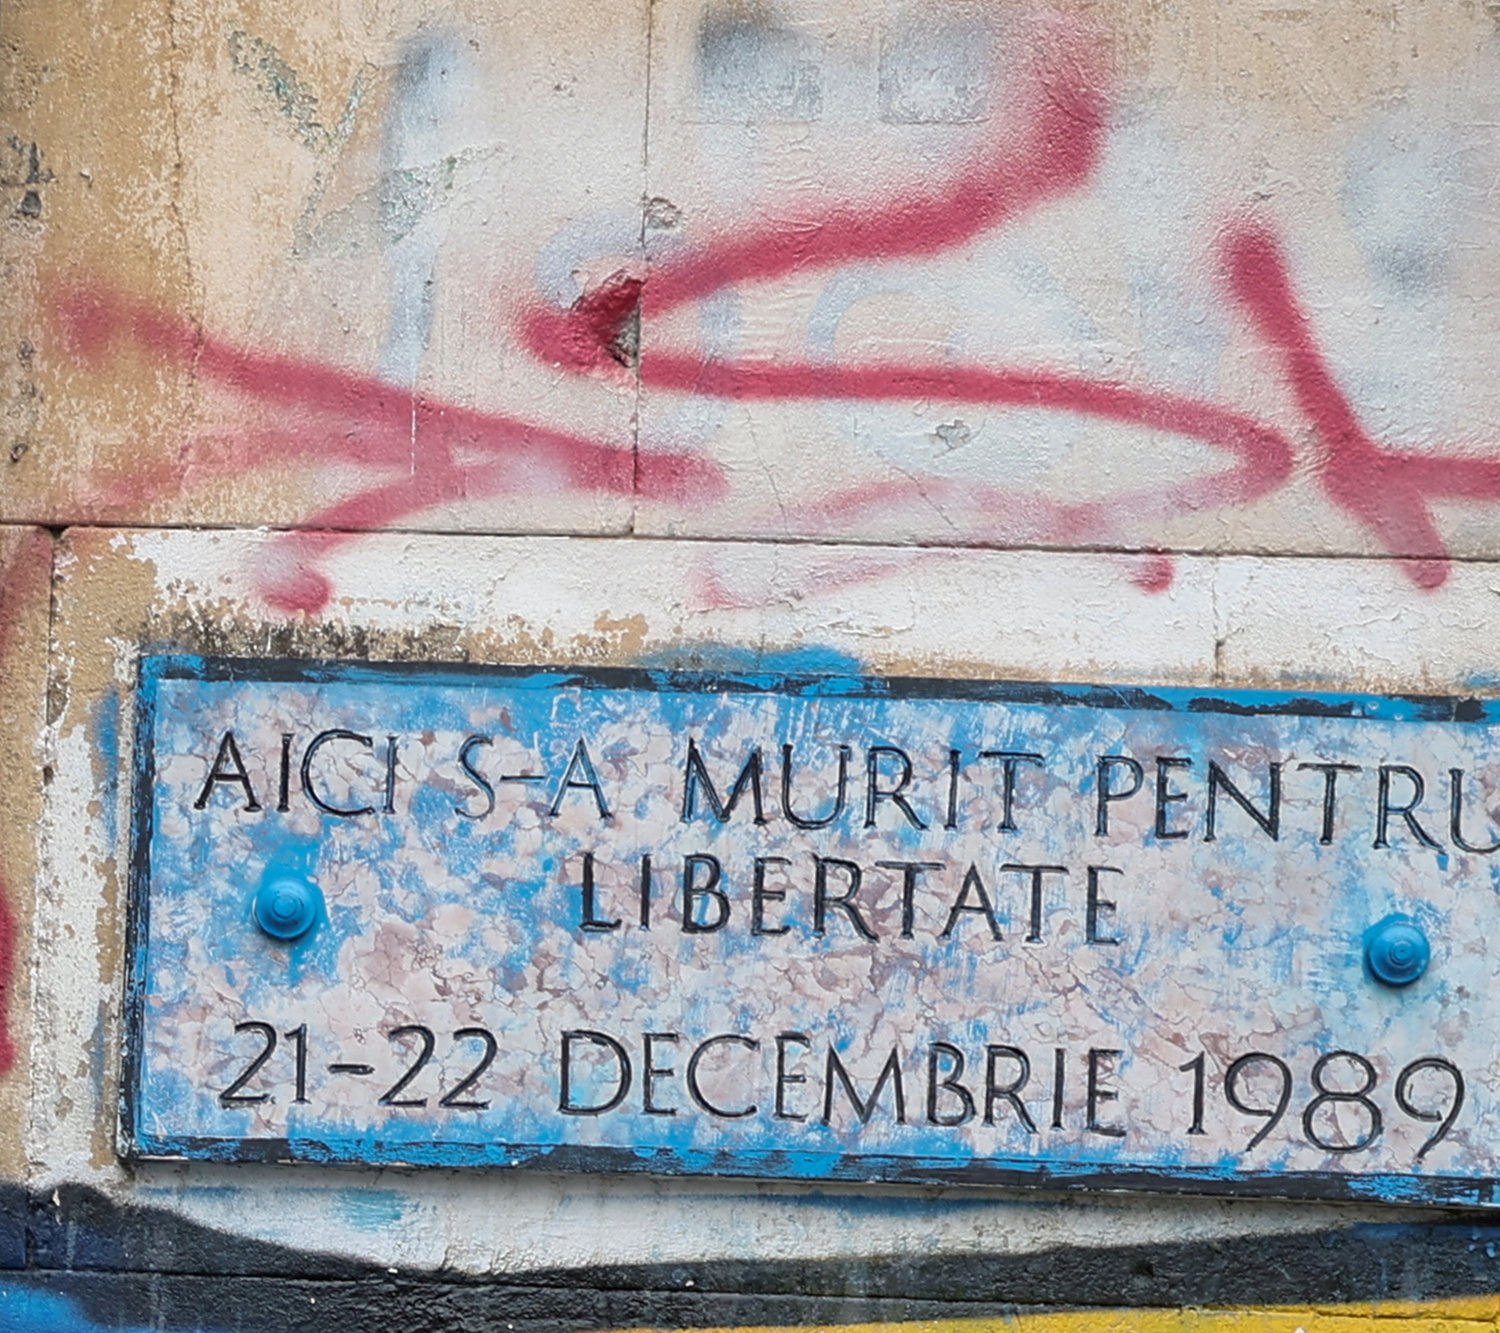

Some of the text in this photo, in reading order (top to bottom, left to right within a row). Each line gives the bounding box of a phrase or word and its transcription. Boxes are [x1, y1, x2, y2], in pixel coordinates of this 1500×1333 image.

[194, 730, 399, 816] AICI
[455, 734, 613, 819] S-A
[680, 736, 1044, 833] MURIT
[580, 851, 1125, 947] LIBERTATE
[218, 1020, 1465, 1160] 21-22 DECEMBRIE 1989
